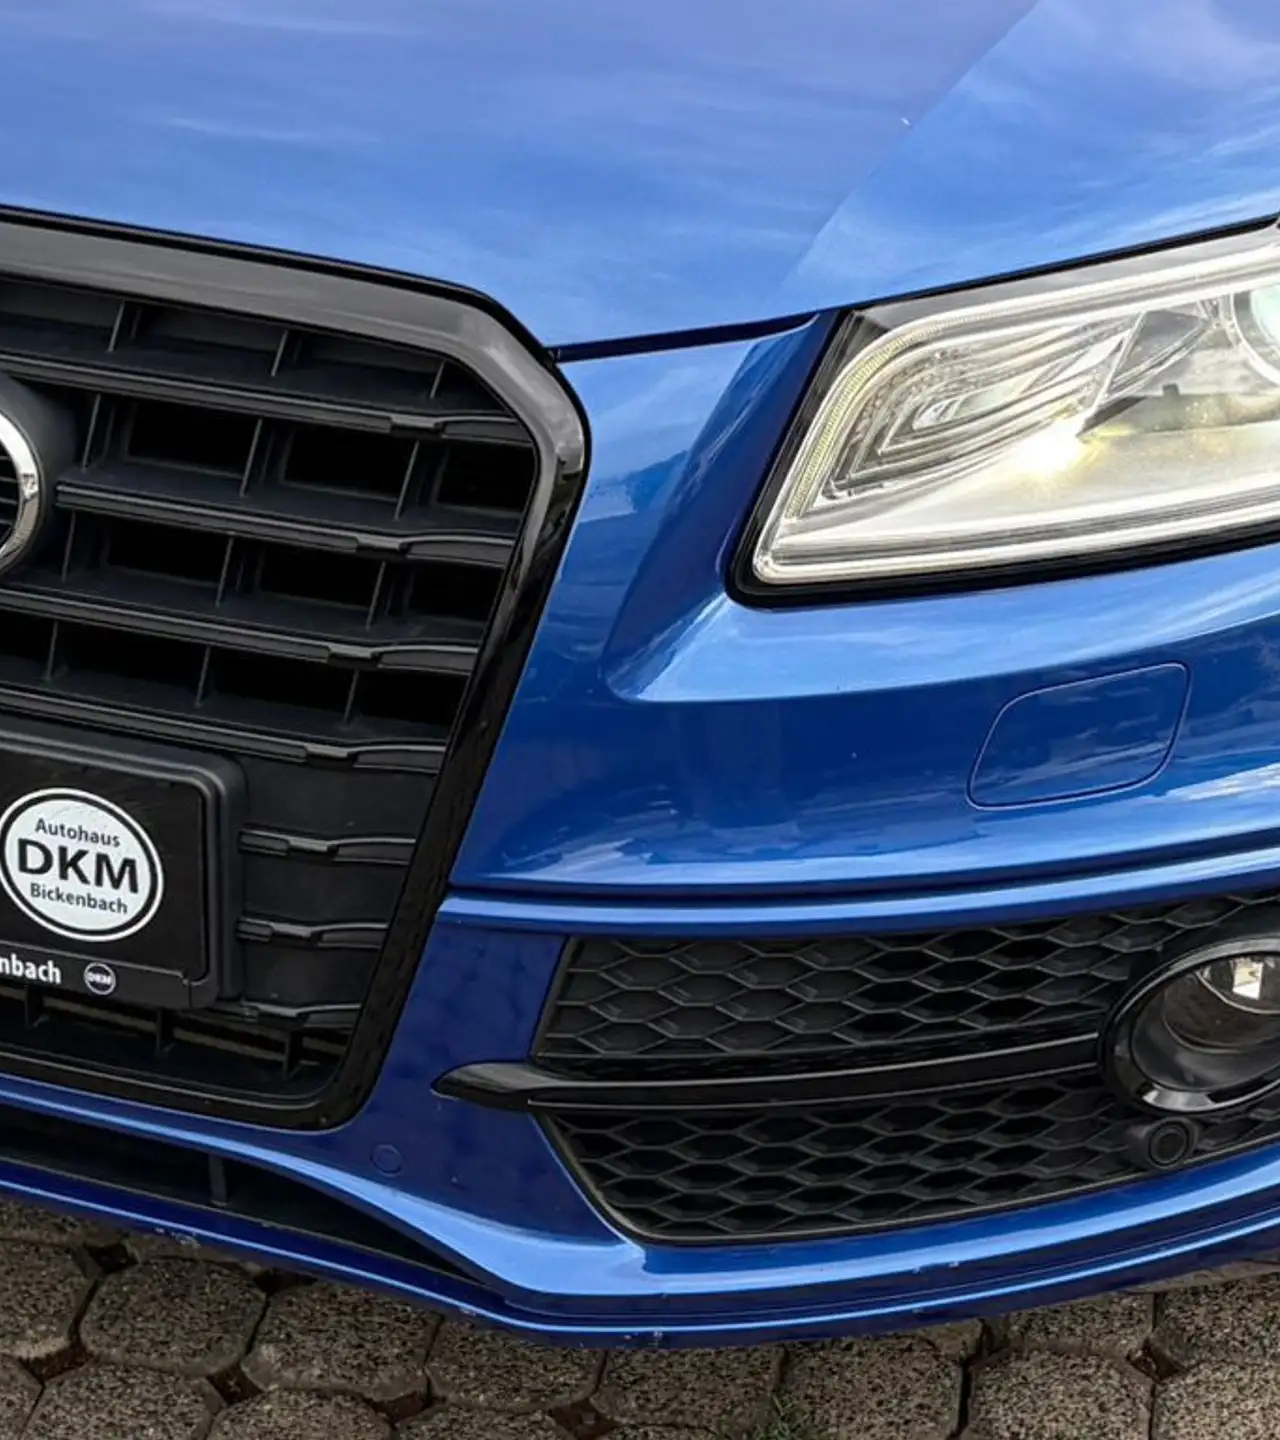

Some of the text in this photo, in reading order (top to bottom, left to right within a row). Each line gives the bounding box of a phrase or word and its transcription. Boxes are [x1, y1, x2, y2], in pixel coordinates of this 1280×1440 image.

[35, 818, 121, 848] Autohaus
[17, 837, 140, 895] DKM
[30, 882, 128, 915] Bickenbach
